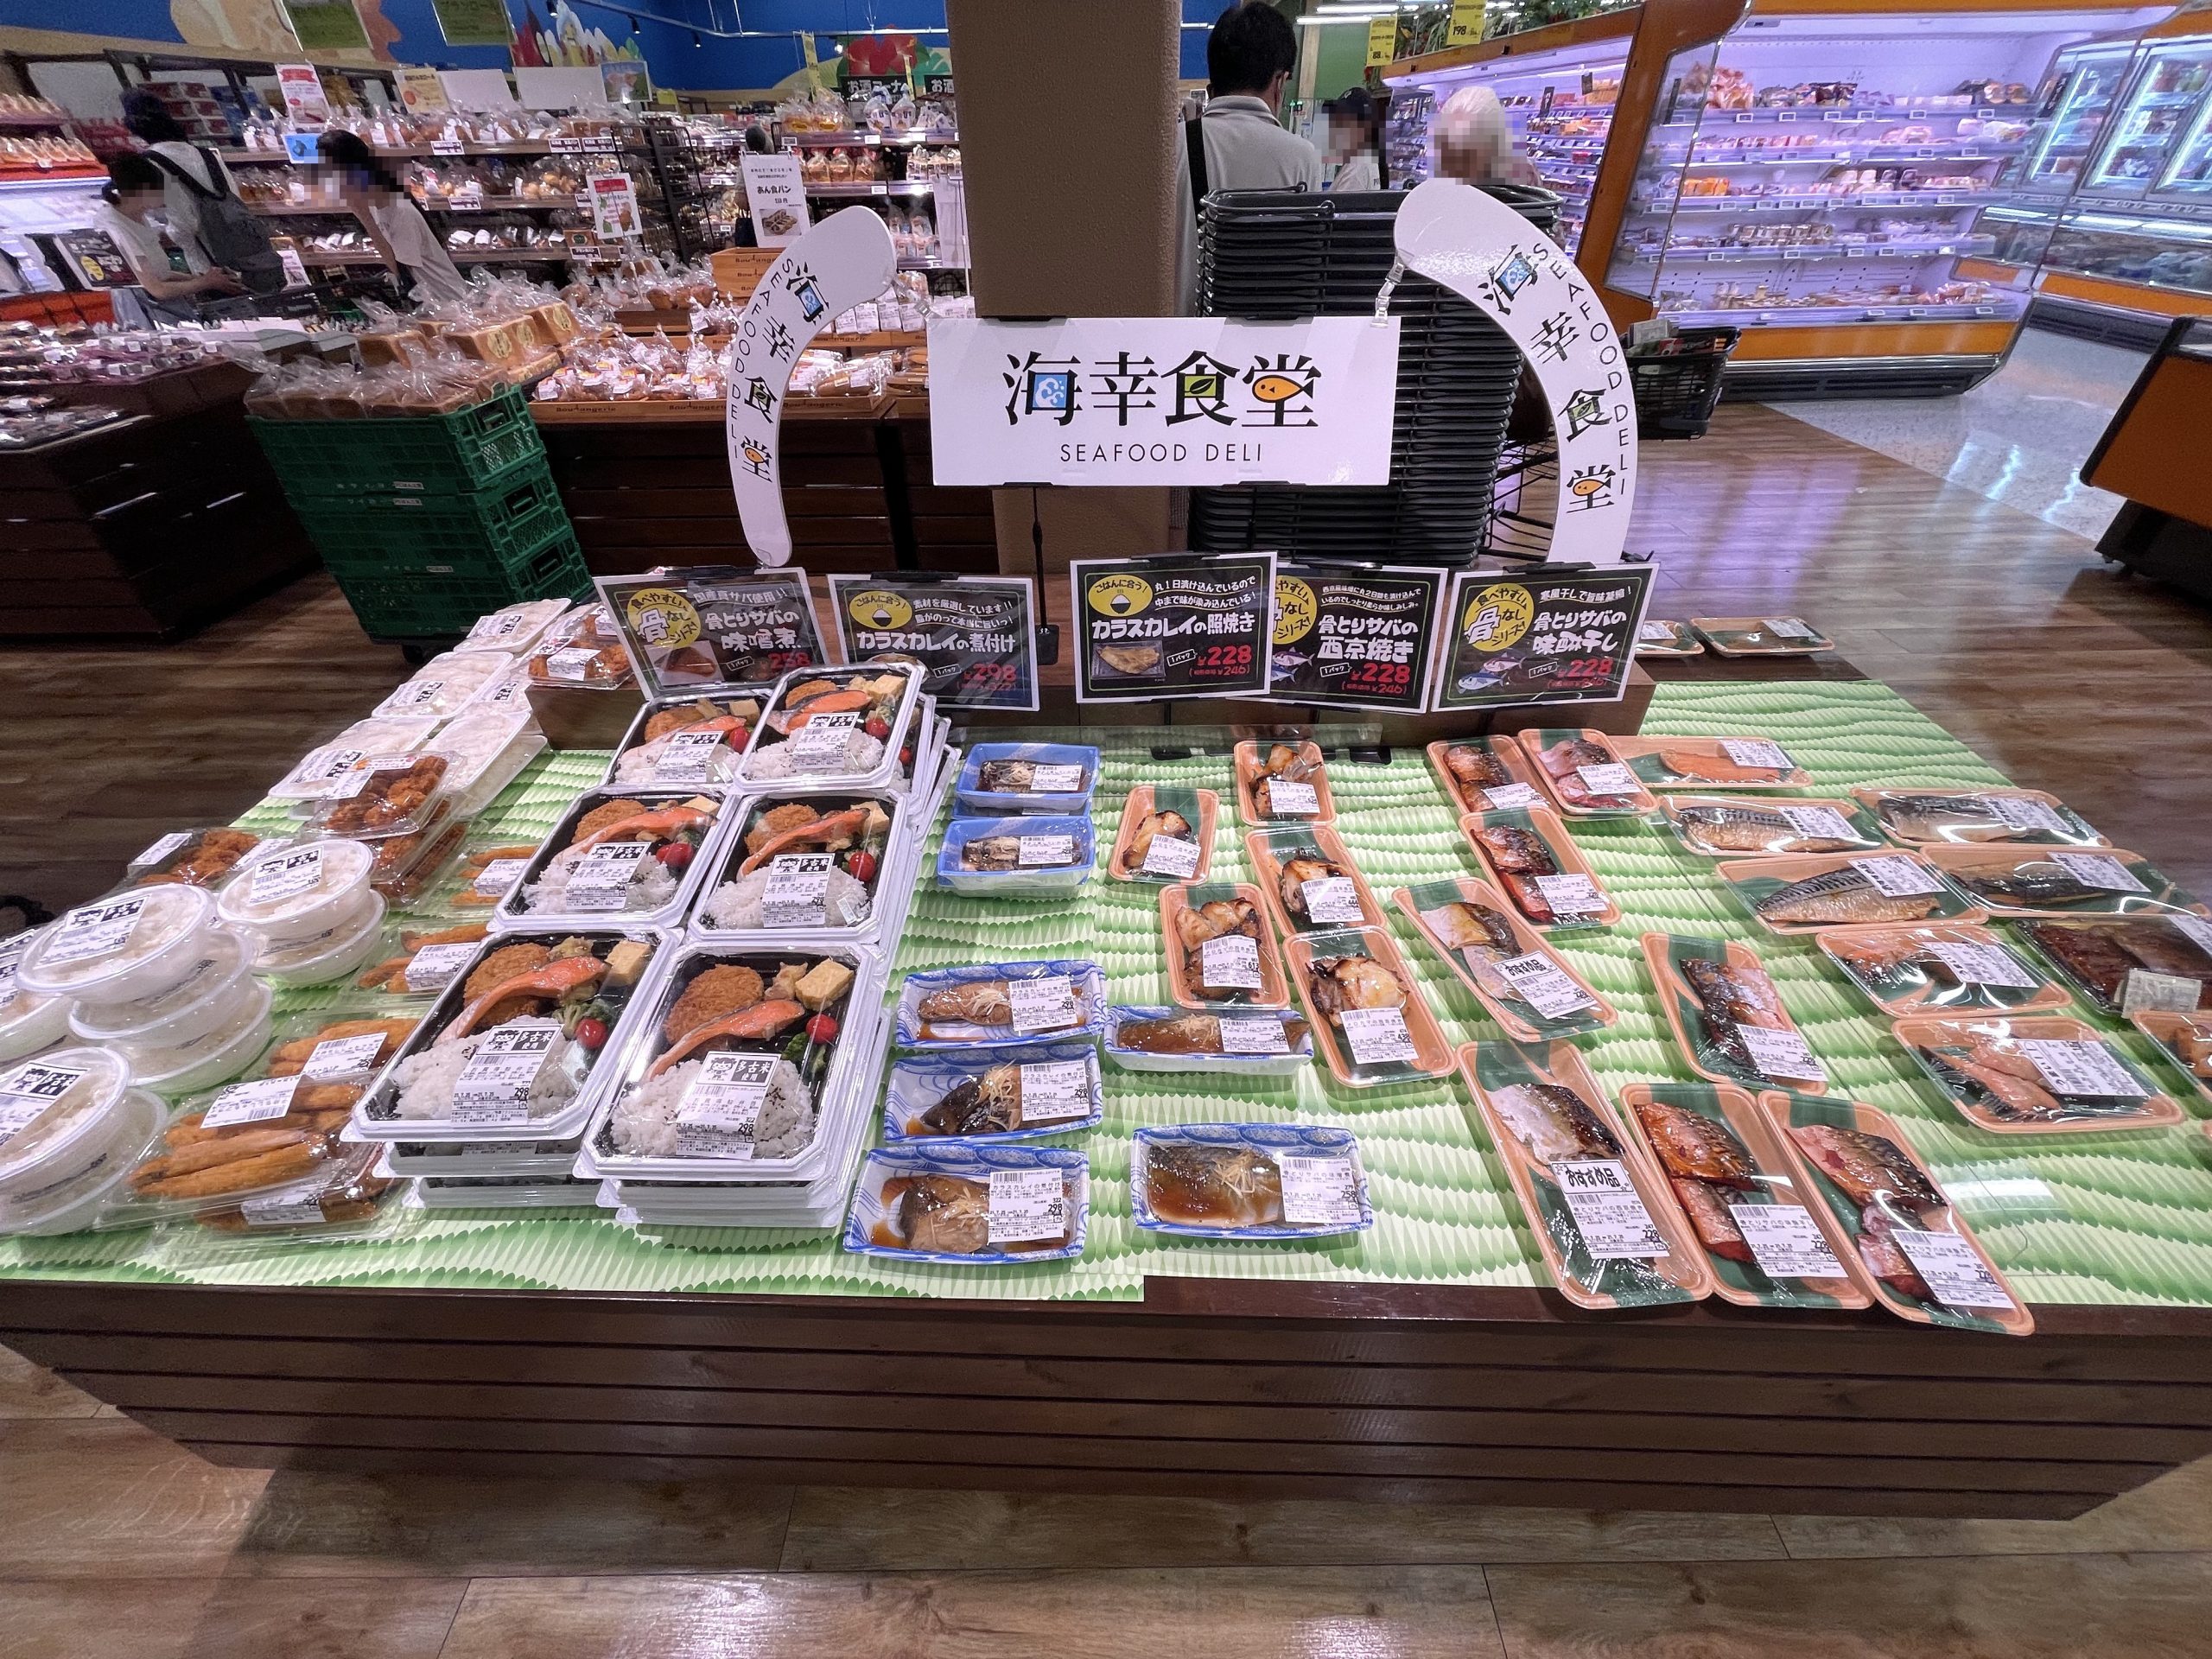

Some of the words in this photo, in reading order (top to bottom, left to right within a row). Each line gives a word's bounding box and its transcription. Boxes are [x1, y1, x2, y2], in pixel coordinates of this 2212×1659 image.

[757, 185, 791, 194] あん食パン
[736, 257, 794, 374] SEAFOOD
[1533, 243, 1623, 391] SEAFOOD
[1614, 404, 1629, 495] DELI
[1002, 350, 1321, 428] 海幸食堂
[731, 384, 741, 460] DELI
[1060, 443, 1187, 463] SEAFOOD
[1205, 443, 1263, 463] DELI
[704, 609, 800, 631] 骨とりサバの
[1092, 612, 1255, 639] カラスカレイの照焼き
[1318, 613, 1419, 636] 骨とりサバの
[1534, 609, 1627, 632] 骨とりサバの
[721, 627, 802, 652] 味噌煮
[856, 631, 1016, 653] カラスカレイの煮付け
[1317, 635, 1414, 664] 西京焼き
[1504, 959, 1547, 976] おすすめ品
[518, 1031, 552, 1043] 多古米
[734, 1060, 772, 1074] 多古米
[514, 1087, 530, 1097] 298
[738, 1123, 753, 1135] 298
[1565, 1166, 1621, 1188] おすすめ品
[1643, 1230, 1660, 1239] 228
